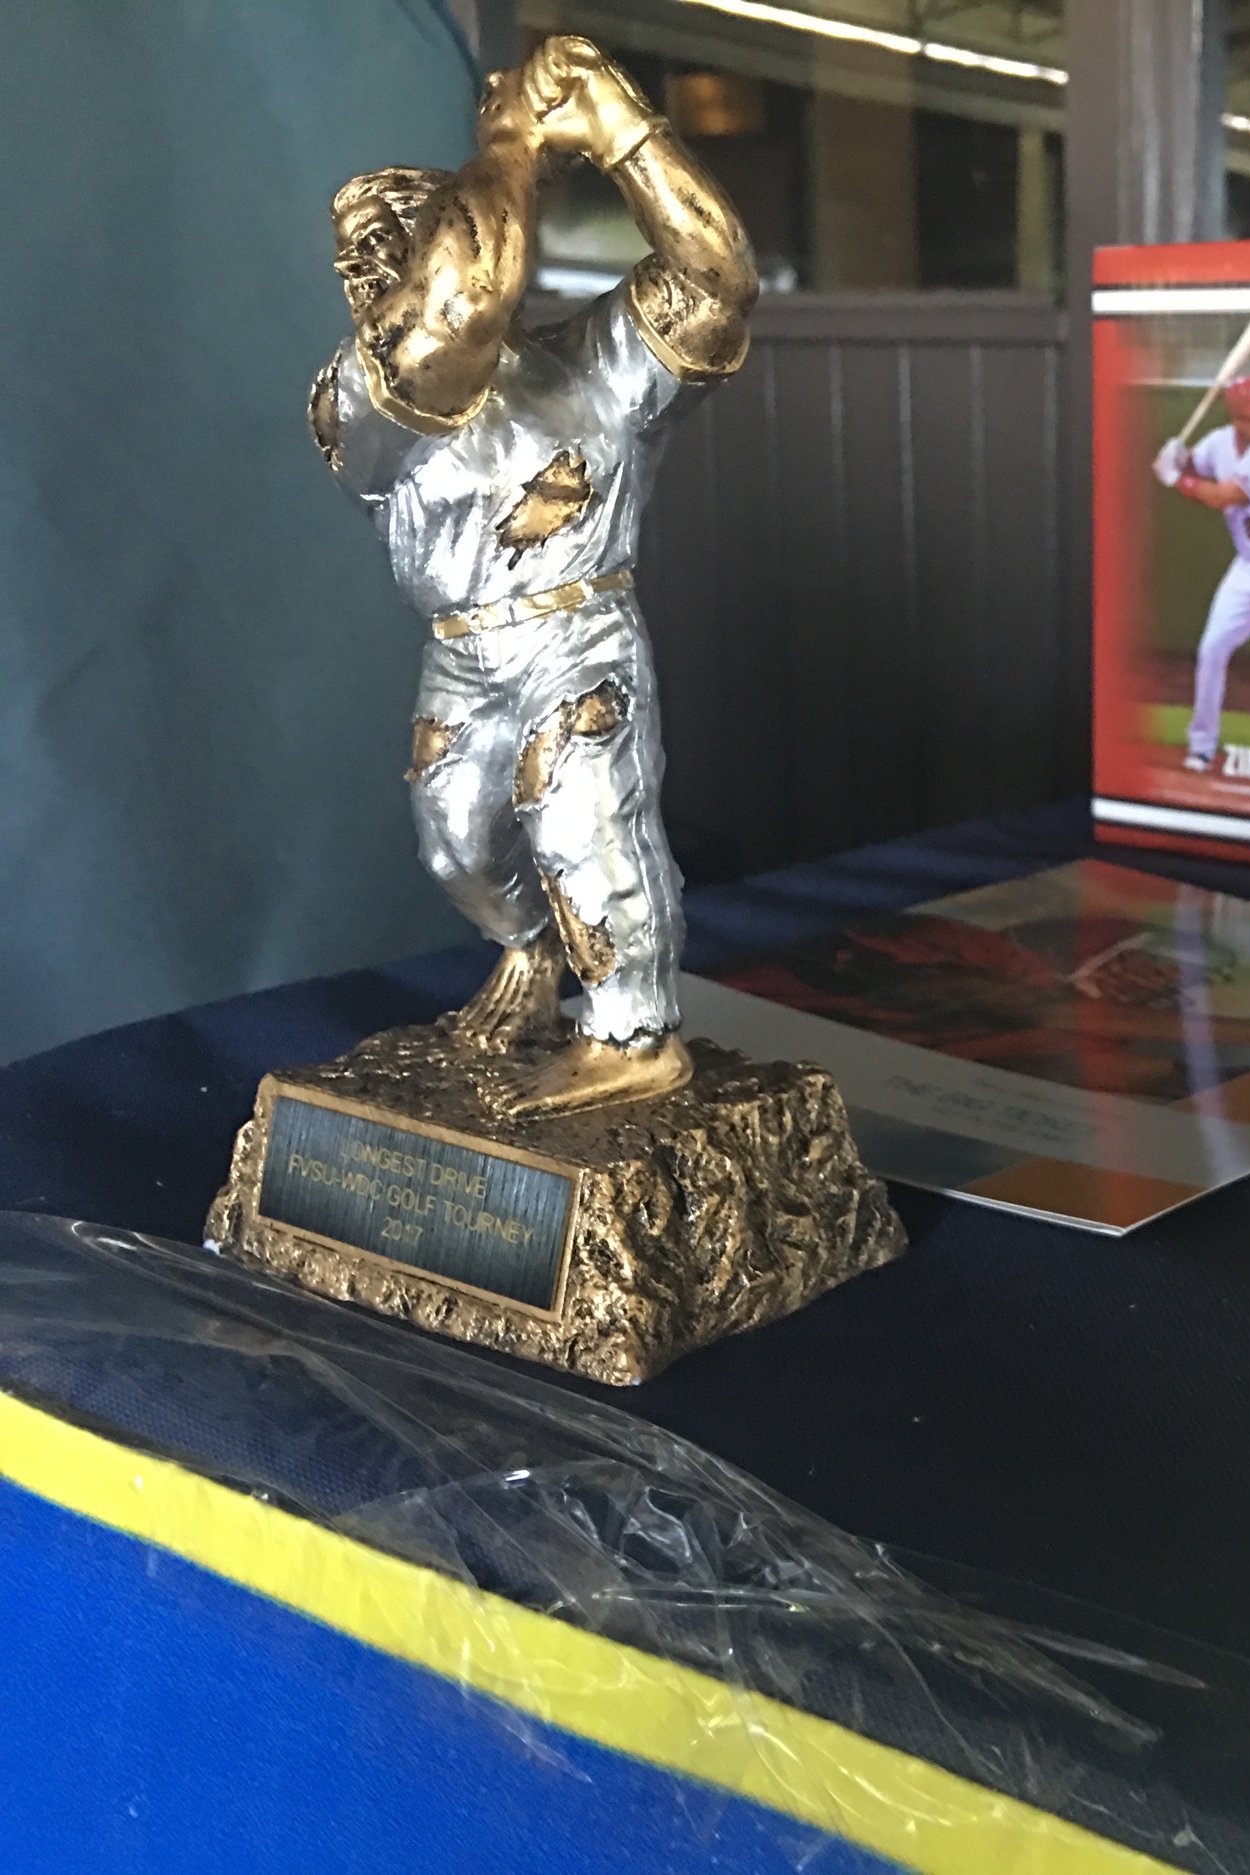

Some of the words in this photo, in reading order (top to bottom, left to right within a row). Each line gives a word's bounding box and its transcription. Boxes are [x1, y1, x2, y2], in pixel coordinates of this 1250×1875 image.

[341, 1139, 426, 1178] LONGEST
[430, 1164, 488, 1199] DRIVE
[288, 1153, 383, 1200] FVSU-WDC
[386, 1184, 437, 1216] GOLF
[443, 1200, 535, 1247] TOURNEY
[380, 1216, 424, 1247] 2017
